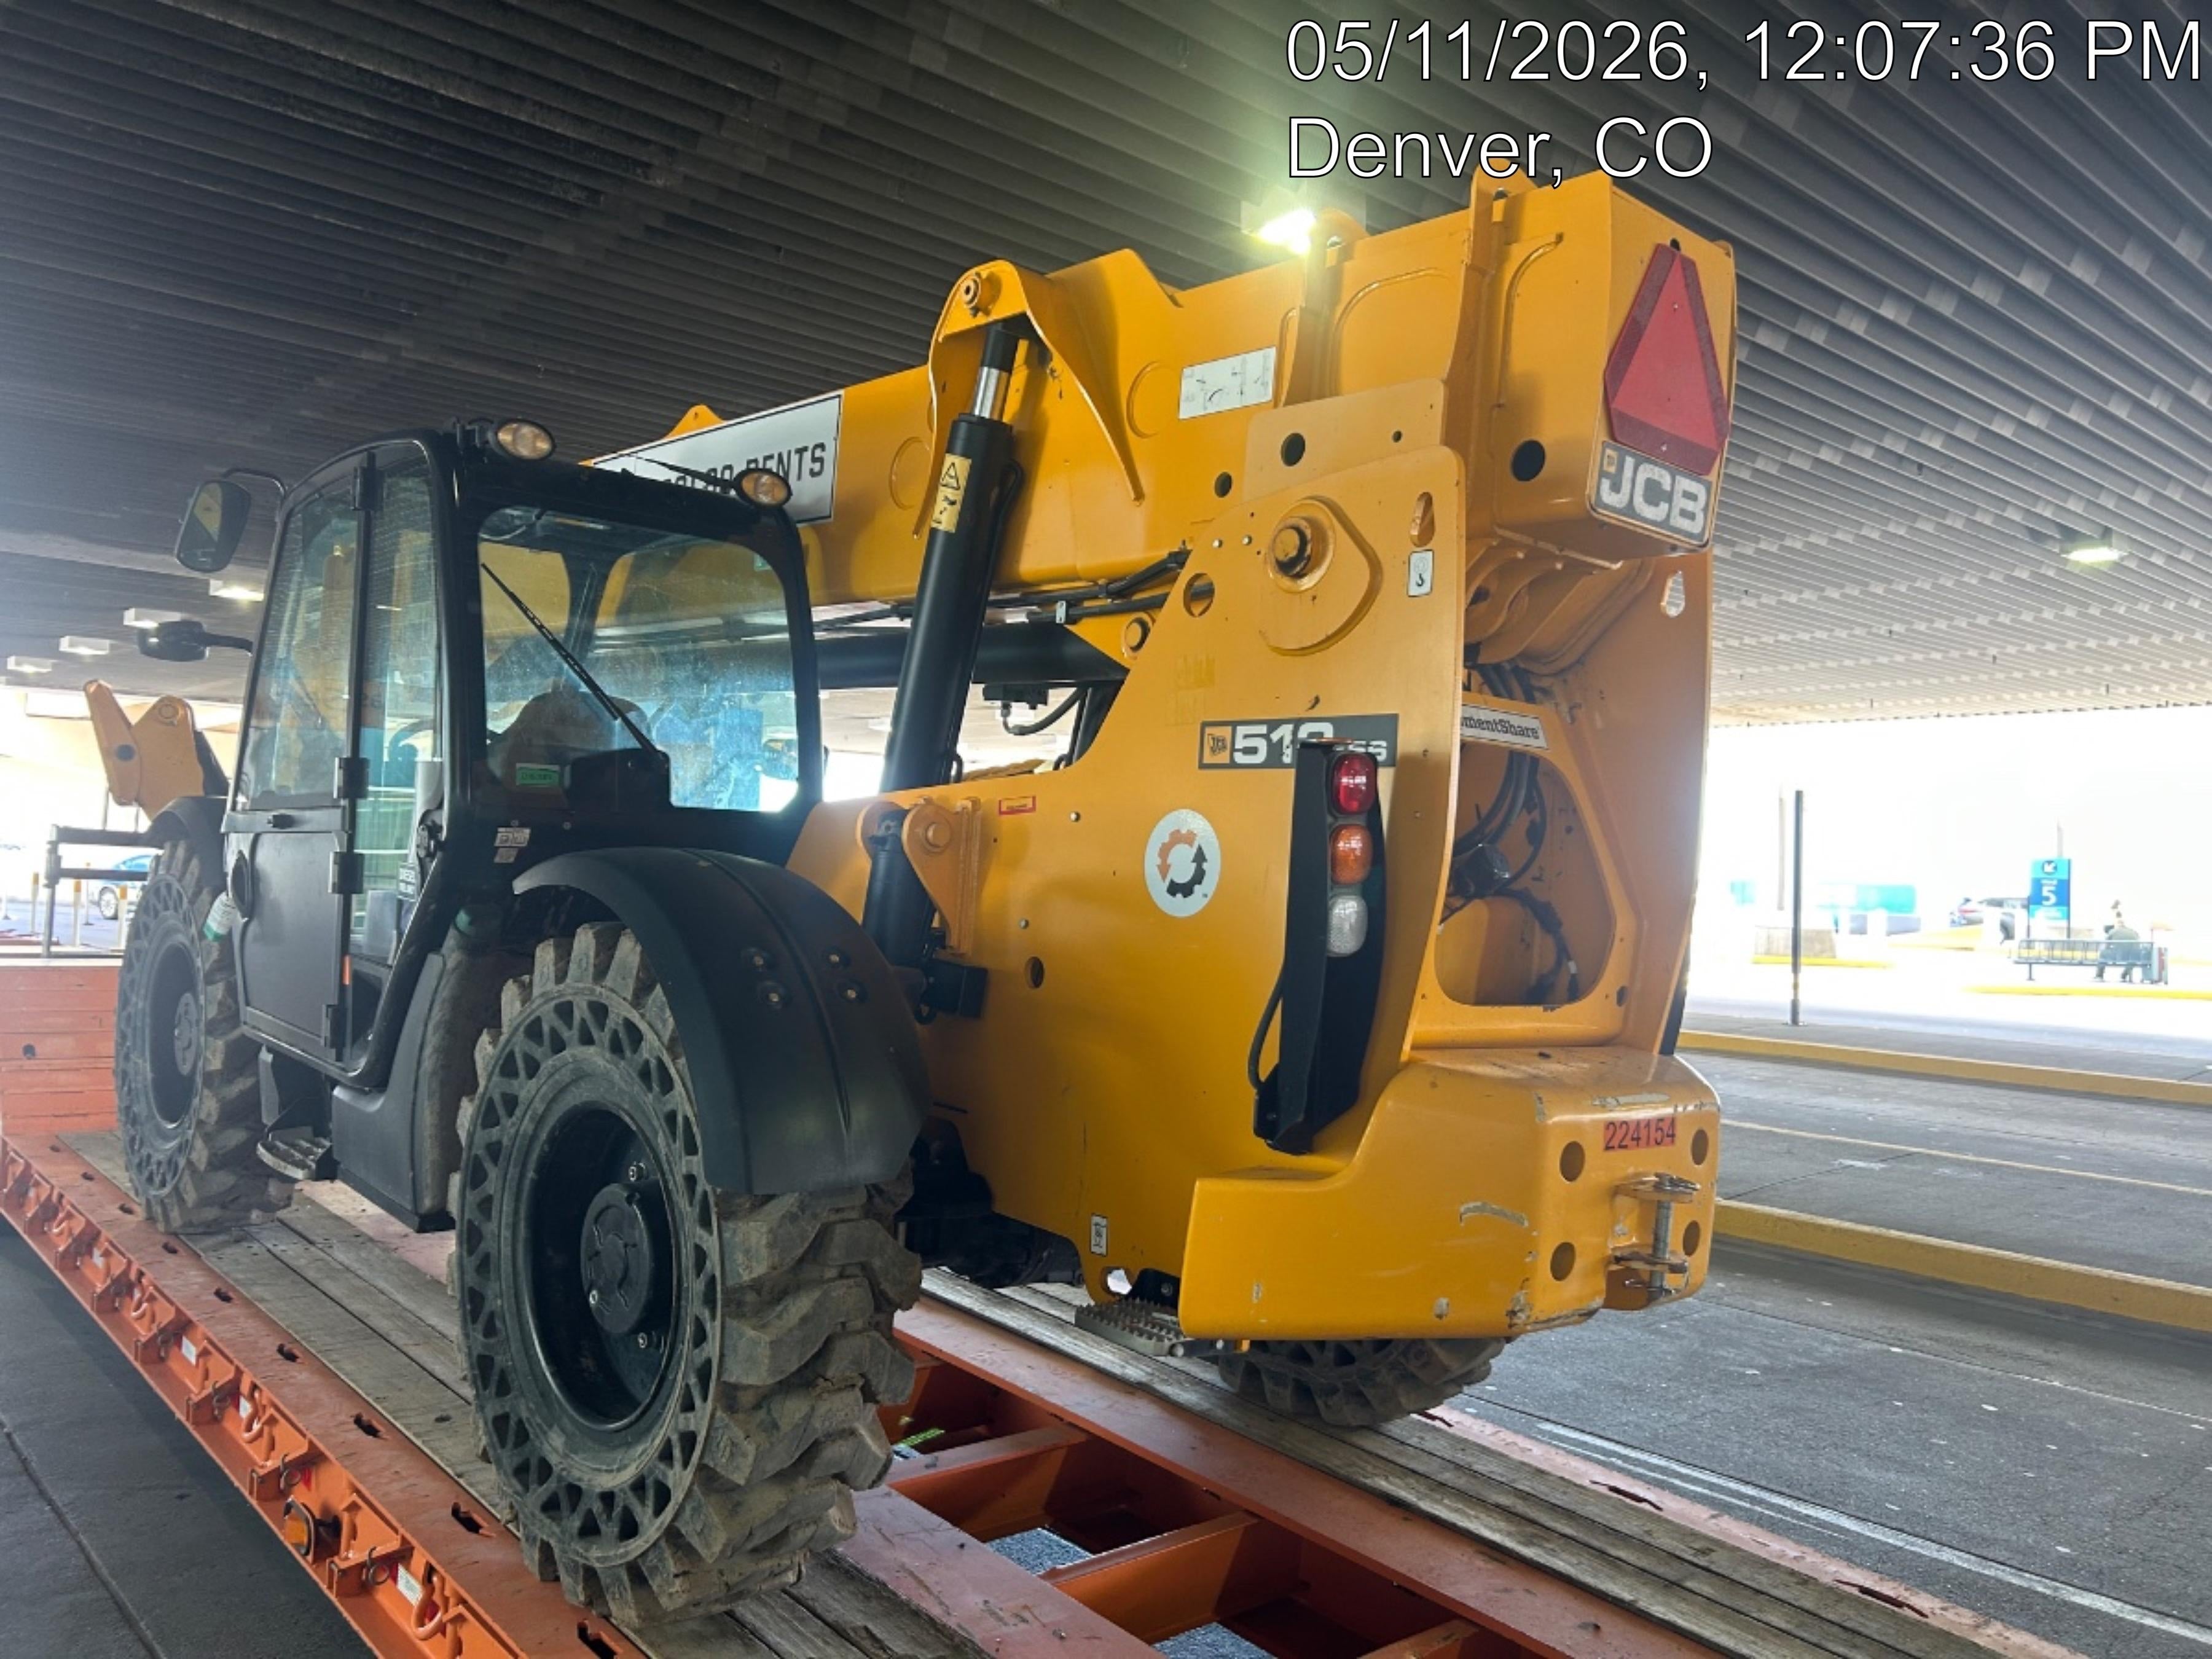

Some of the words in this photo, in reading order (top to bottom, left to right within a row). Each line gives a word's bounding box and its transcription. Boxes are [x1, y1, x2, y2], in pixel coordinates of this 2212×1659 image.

[1599, 455, 1708, 534] JCB
[2042, 886, 2057, 906] 5
[1604, 1113, 1676, 1151] 224154
